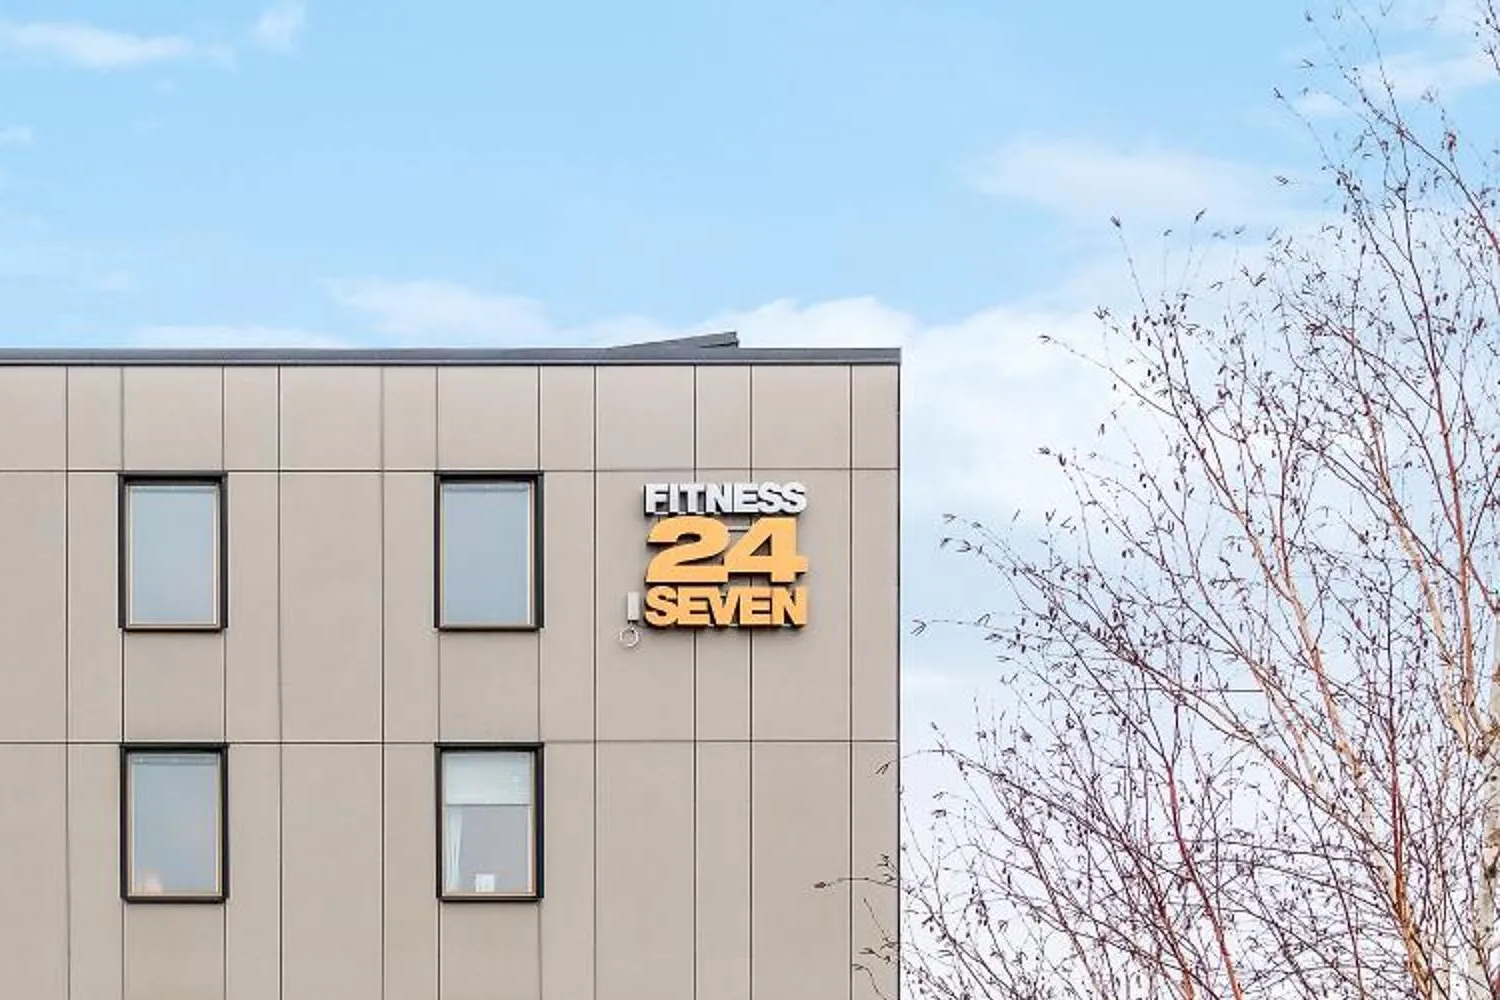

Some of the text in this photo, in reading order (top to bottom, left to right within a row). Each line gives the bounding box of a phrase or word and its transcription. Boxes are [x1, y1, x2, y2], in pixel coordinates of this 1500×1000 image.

[644, 481, 807, 515] FITNESS
[645, 515, 808, 583] 24
[644, 585, 808, 627] SEVEN
